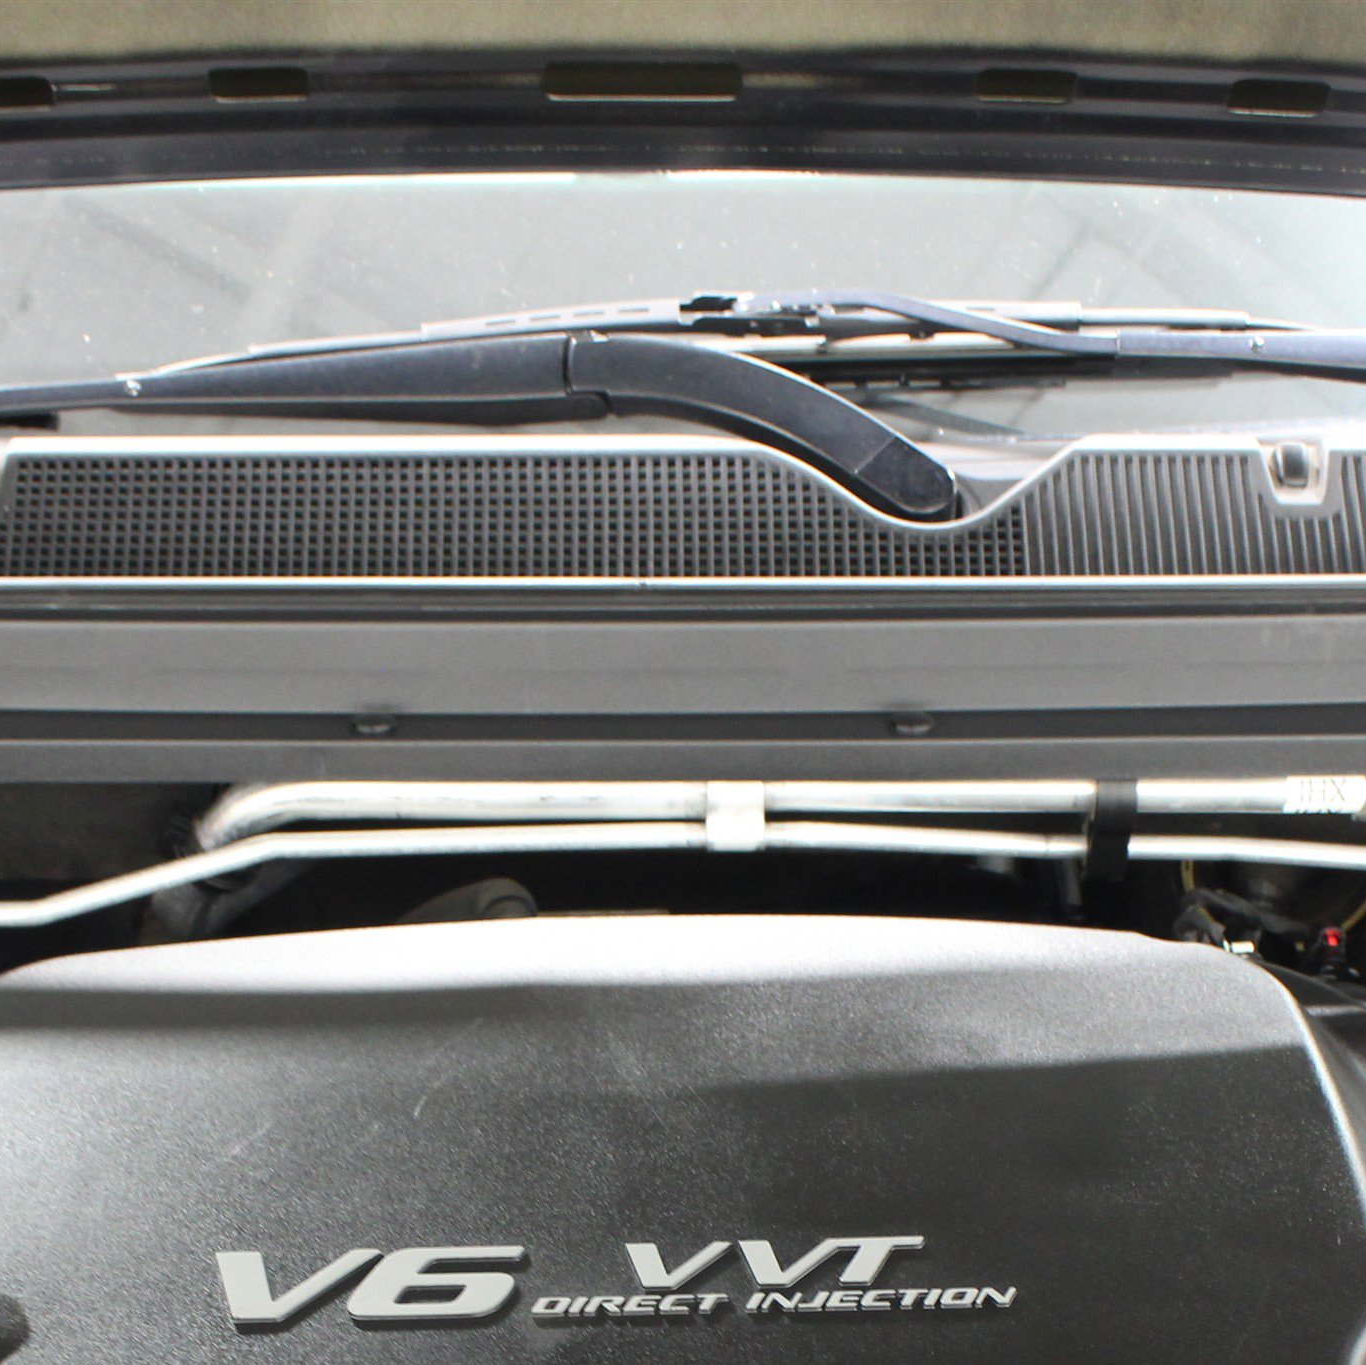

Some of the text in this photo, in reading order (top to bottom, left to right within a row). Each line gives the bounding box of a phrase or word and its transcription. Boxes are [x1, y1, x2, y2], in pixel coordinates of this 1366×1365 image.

[215, 1234, 925, 1327] V6 VVT
[530, 1285, 1018, 1319] DIRECT INJECTION
